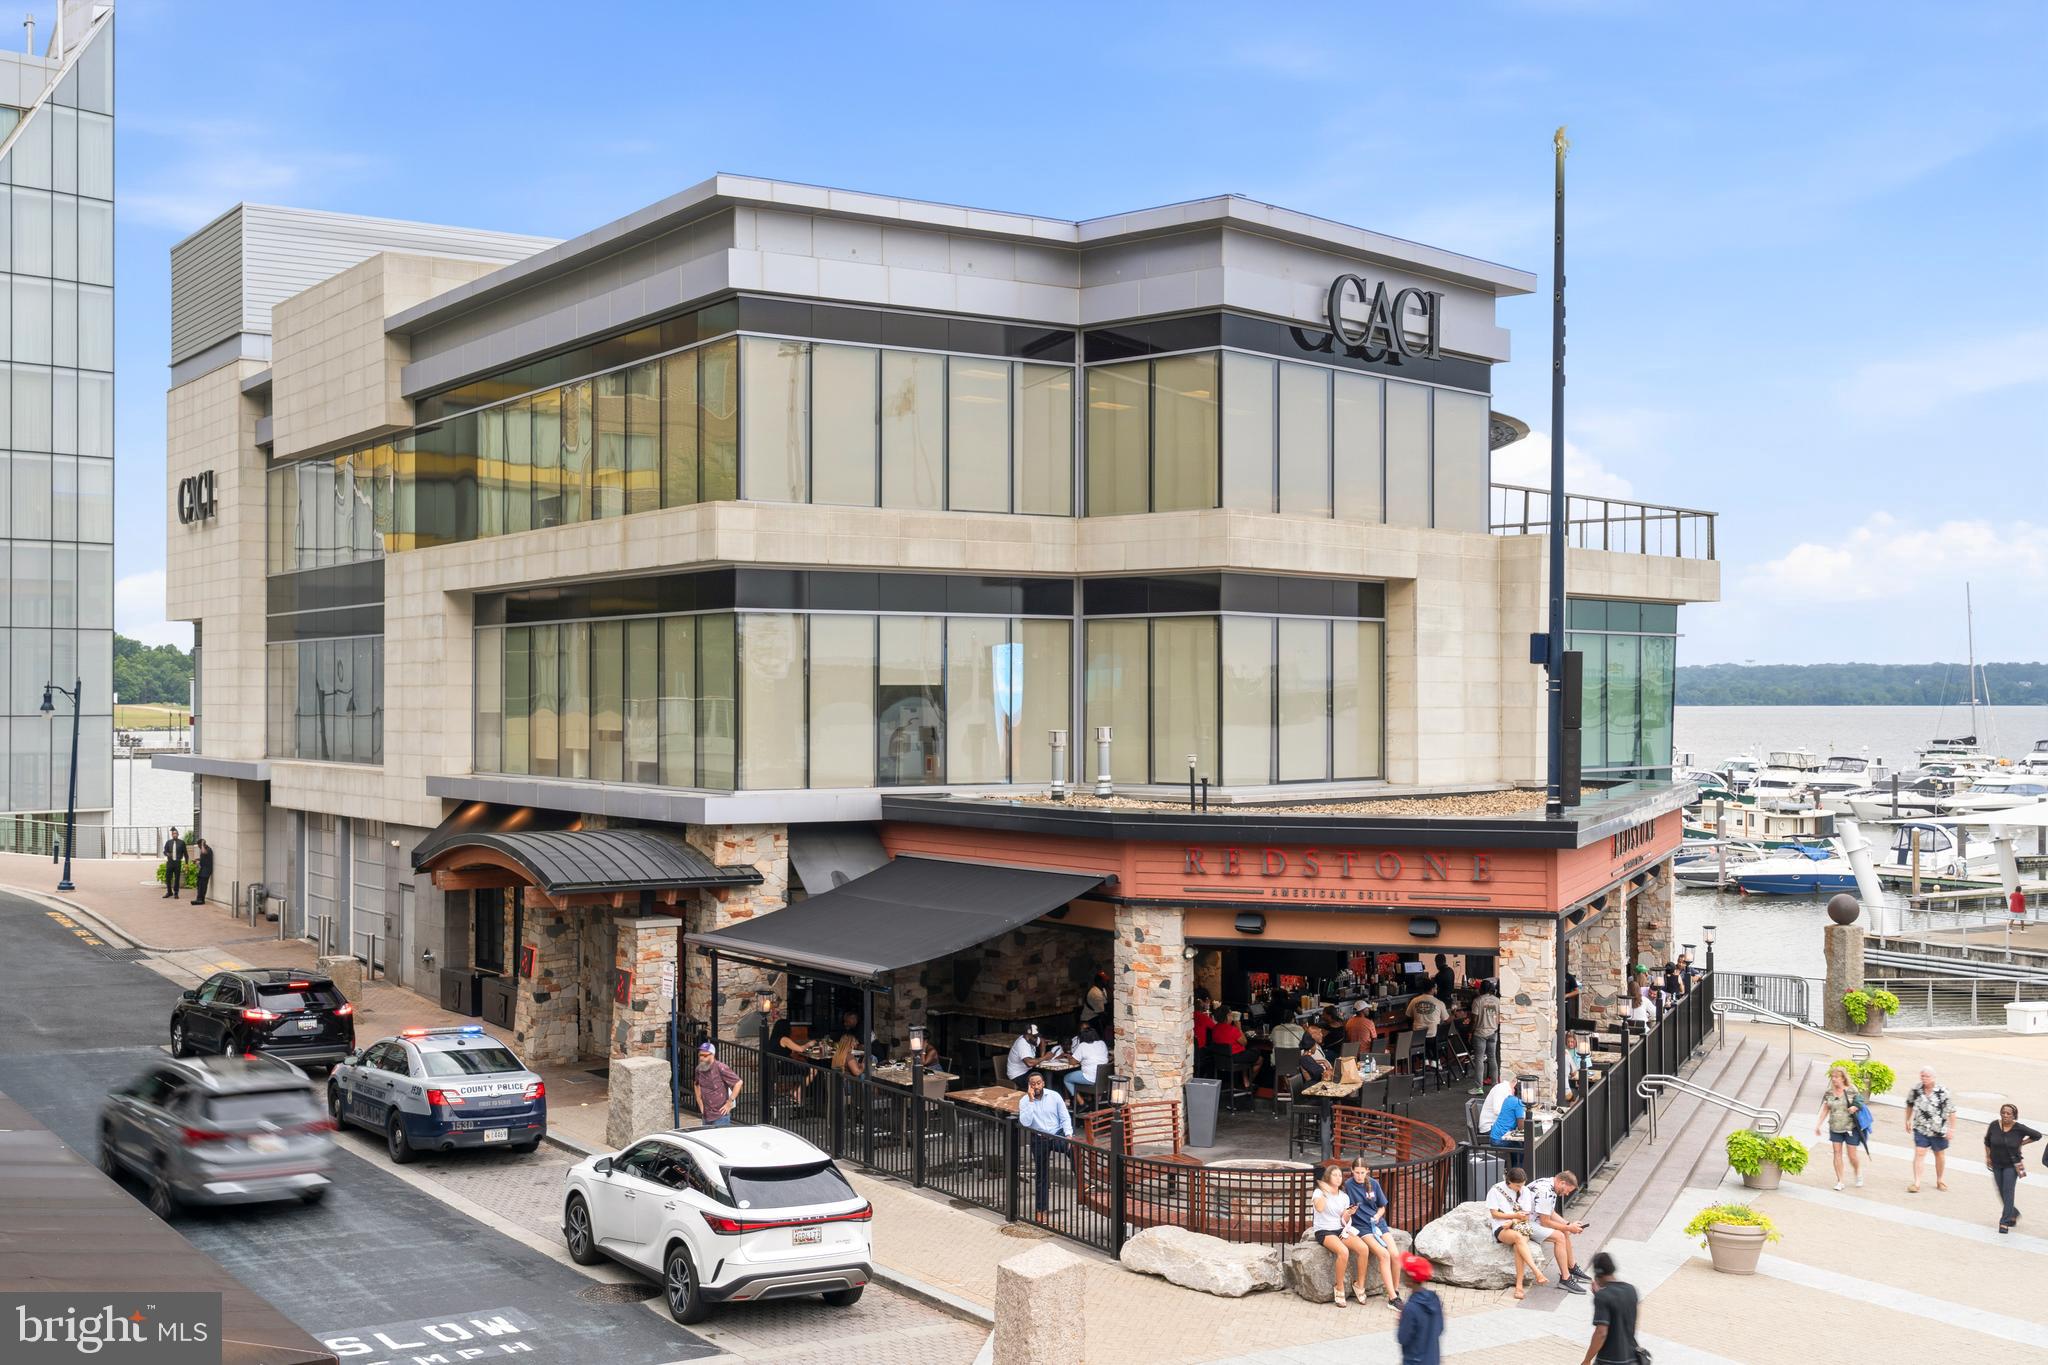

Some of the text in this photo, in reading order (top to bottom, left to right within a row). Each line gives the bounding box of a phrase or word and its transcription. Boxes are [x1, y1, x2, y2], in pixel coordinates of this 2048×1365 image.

[1328, 273, 1445, 361] CACI
[178, 470, 214, 524] CACI
[1612, 818, 1656, 859] REDSTONE
[1184, 848, 1491, 882] REDSTONE
[1271, 887, 1400, 901] AMERICAN GRILL
[461, 1083, 524, 1095] COUNTY POLICE
[452, 1121, 474, 1130] 1530
[324, 1316, 521, 1356] SLOW
